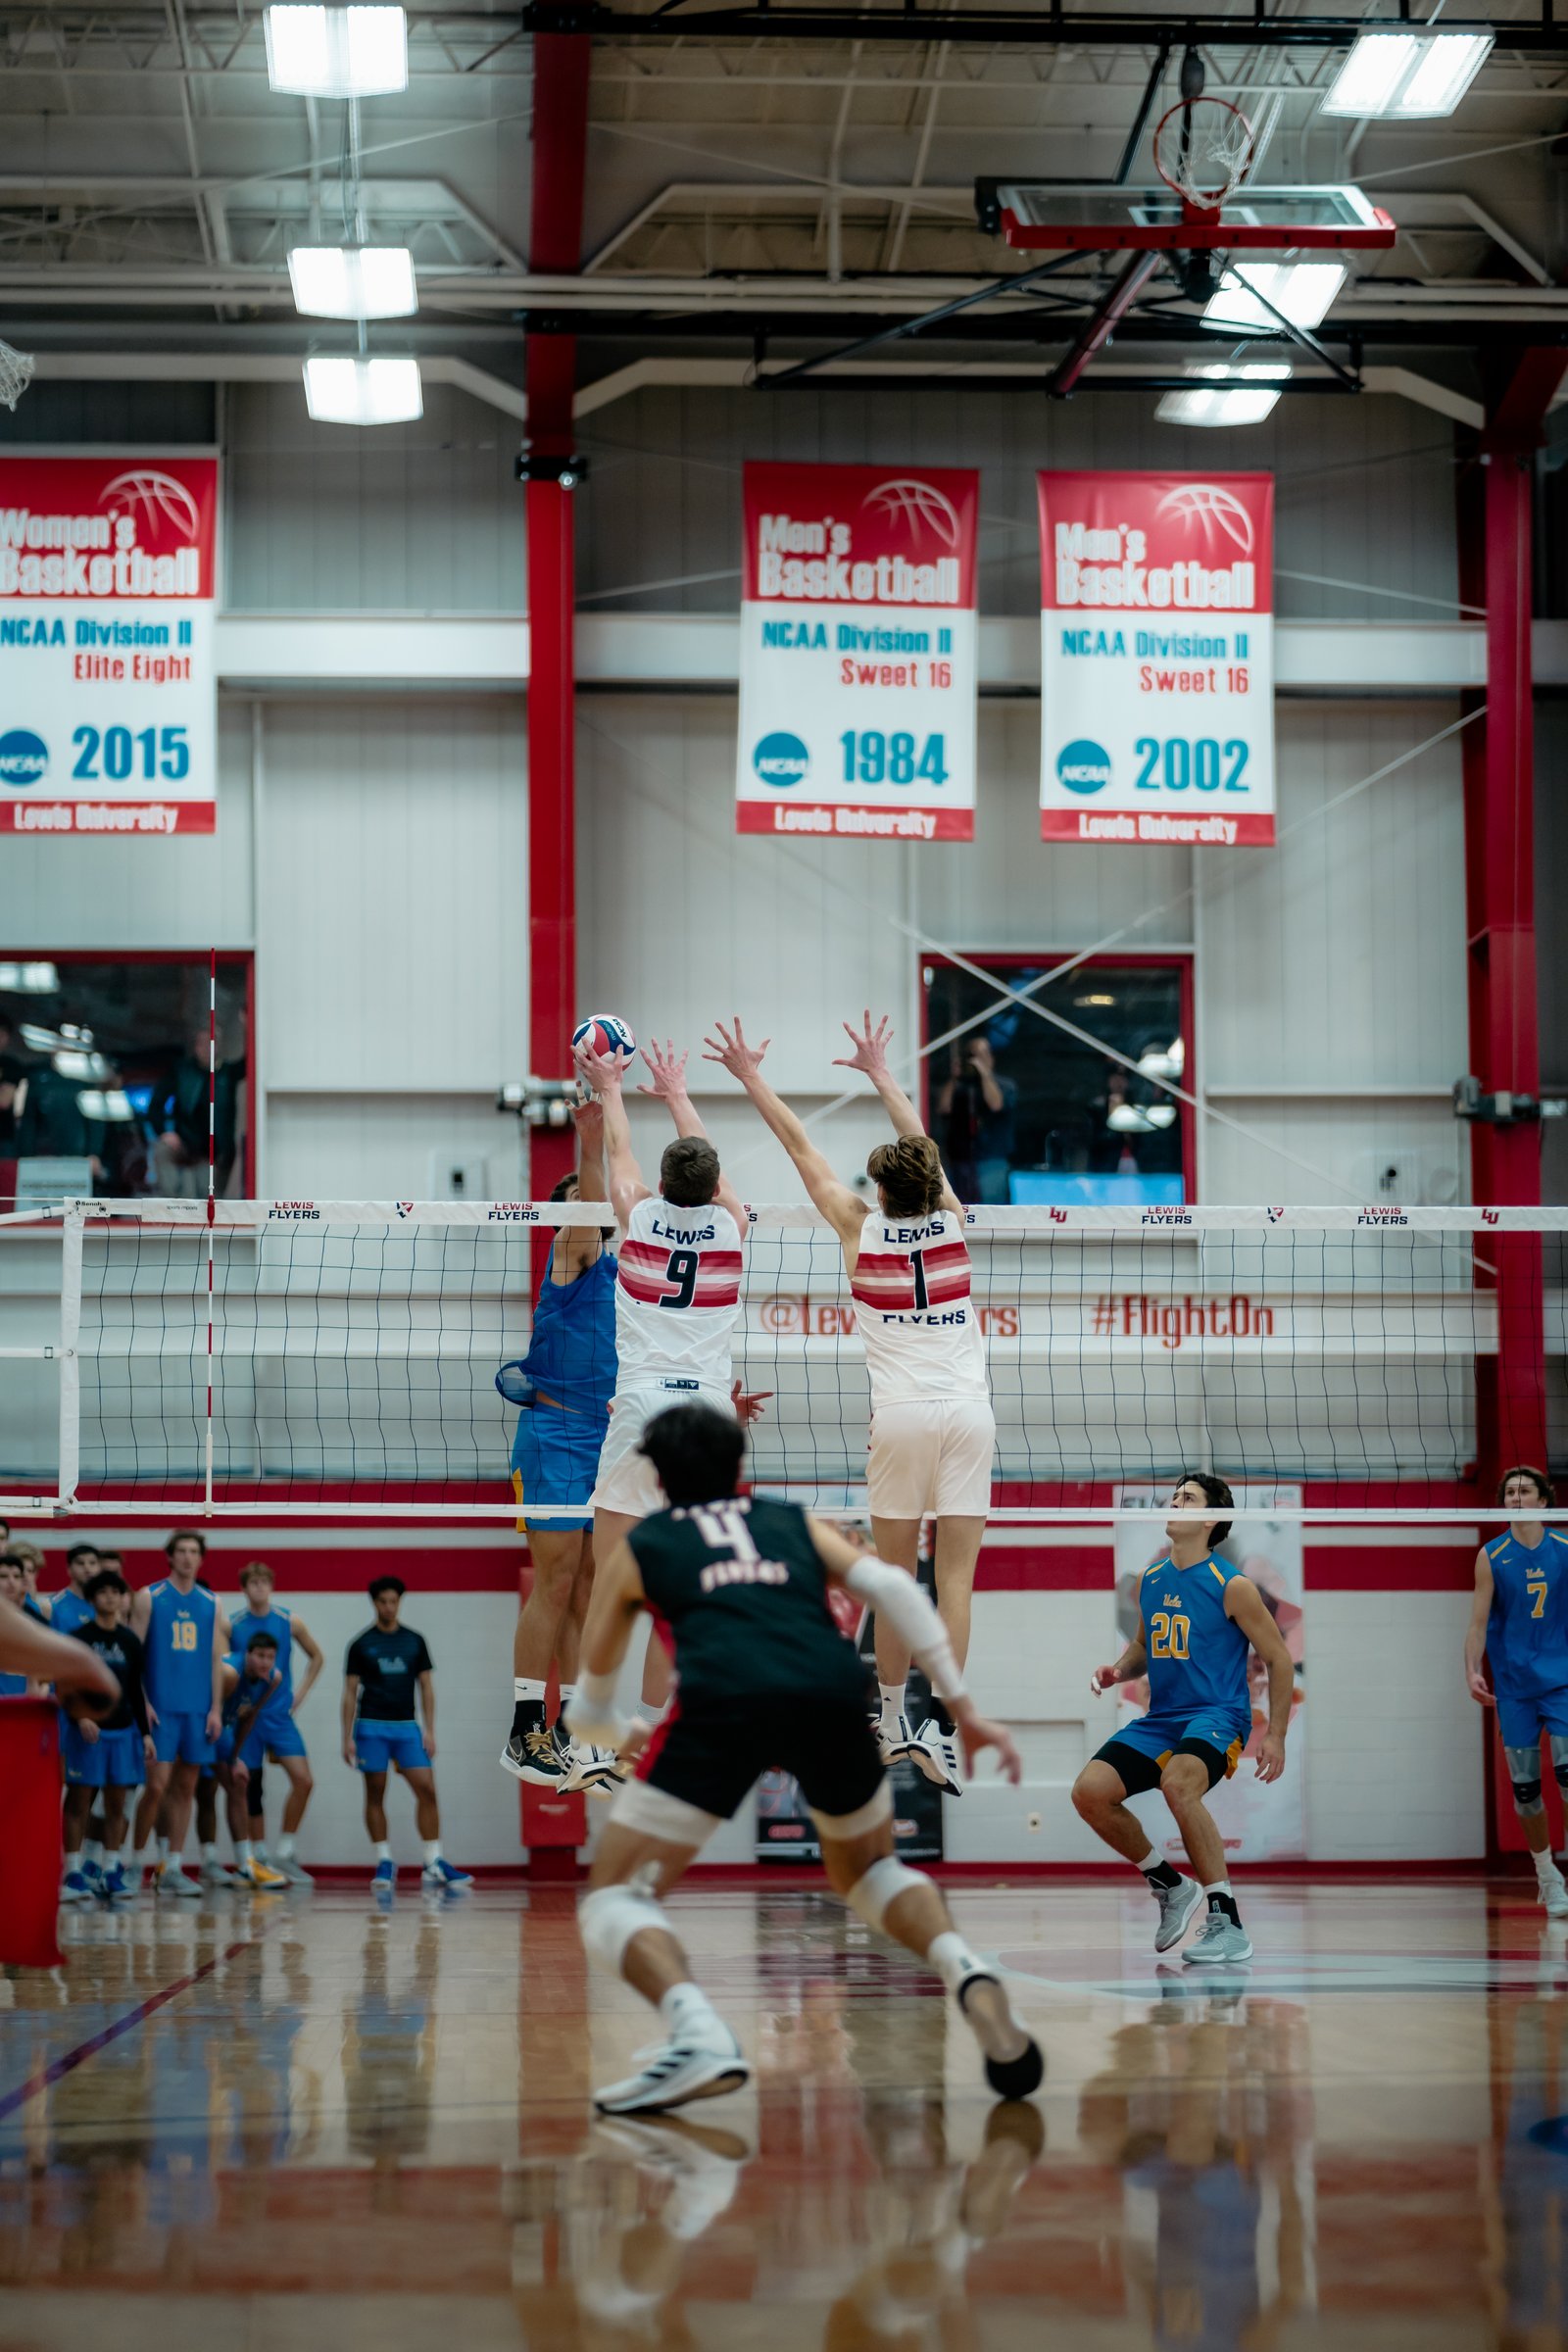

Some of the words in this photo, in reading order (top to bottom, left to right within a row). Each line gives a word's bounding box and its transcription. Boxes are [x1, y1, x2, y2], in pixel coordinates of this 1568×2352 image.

[0, 507, 136, 550] Women's
[759, 513, 852, 556] Men's
[1055, 521, 1147, 563] Men's
[0, 547, 200, 596] Basketball
[759, 552, 959, 605] Basketball
[1056, 560, 1255, 610] Basketball
[1, 619, 65, 647] NCAA
[75, 619, 170, 647] Division
[761, 620, 827, 651] NCAA
[837, 623, 929, 654] Division
[938, 626, 952, 653] II
[1061, 629, 1126, 658] NCAA
[1136, 631, 1226, 659] Division
[1236, 633, 1249, 659] II
[74, 654, 124, 680] Elite
[133, 654, 191, 684] Eight
[841, 659, 918, 688] Sweet
[930, 662, 951, 689] 16
[1140, 665, 1216, 694] Sweet
[1228, 667, 1249, 694] 16
[72, 724, 190, 780] 2015
[840, 729, 949, 785] 1984
[1135, 737, 1250, 792] 2002
[14, 803, 72, 831] Lewis
[75, 804, 178, 834] University
[775, 805, 832, 833] Lewis
[836, 808, 936, 839] University
[1079, 812, 1135, 840] Lewis
[1138, 813, 1237, 844] University
[269, 1209, 320, 1219] FLYERS
[488, 1211, 540, 1221] FLYERS
[1142, 1215, 1193, 1224] FLYERS
[1357, 1215, 1408, 1225] FLYERS
[652, 1219, 715, 1245] LEWIS
[884, 1220, 945, 1244] LEWIS
[659, 1250, 699, 1308] 9
[908, 1250, 929, 1310] 1
[1091, 1294, 1274, 1349] #FlightOn
[694, 1510, 762, 1564] 4
[1527, 1582, 1548, 1619] 7
[172, 1620, 197, 1651] 18
[1151, 1612, 1191, 1660] 20
